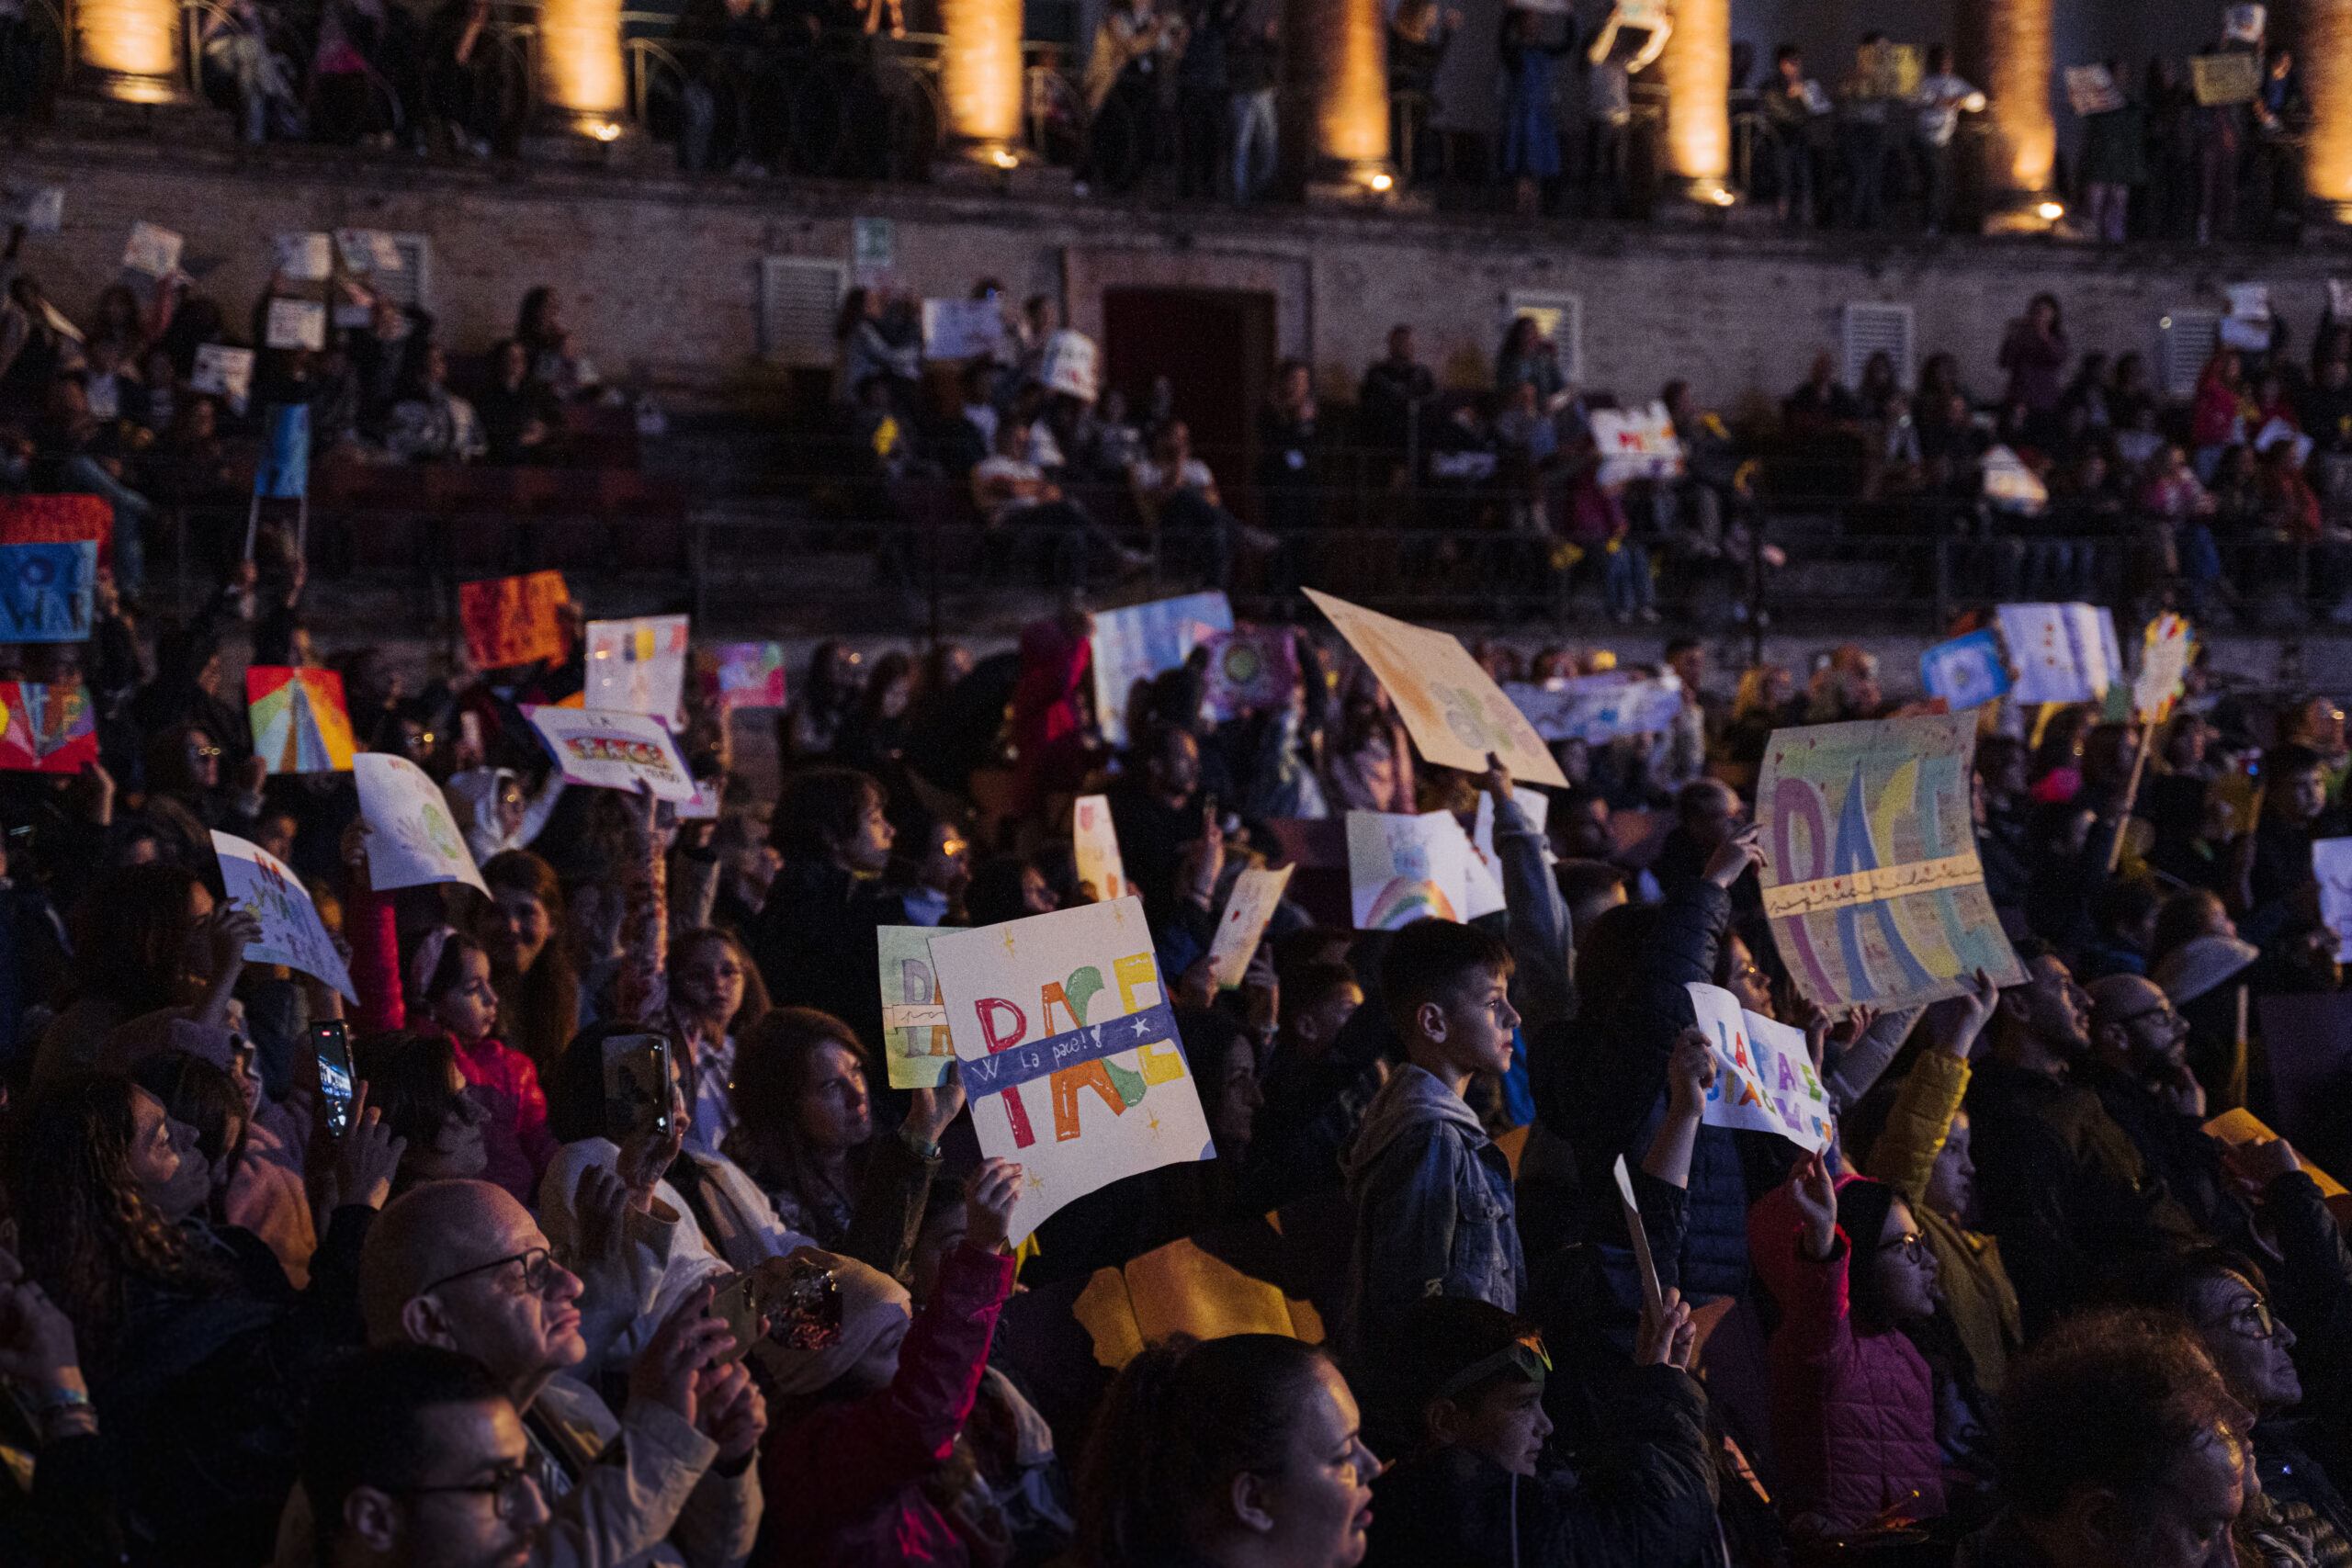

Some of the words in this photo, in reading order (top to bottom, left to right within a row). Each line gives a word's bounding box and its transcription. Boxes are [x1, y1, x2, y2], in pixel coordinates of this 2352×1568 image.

[1773, 754, 2010, 1004] PACE
[971, 1058, 999, 1081] W
[974, 951, 1185, 1149] PACE
[1717, 1021, 1756, 1077] LA
